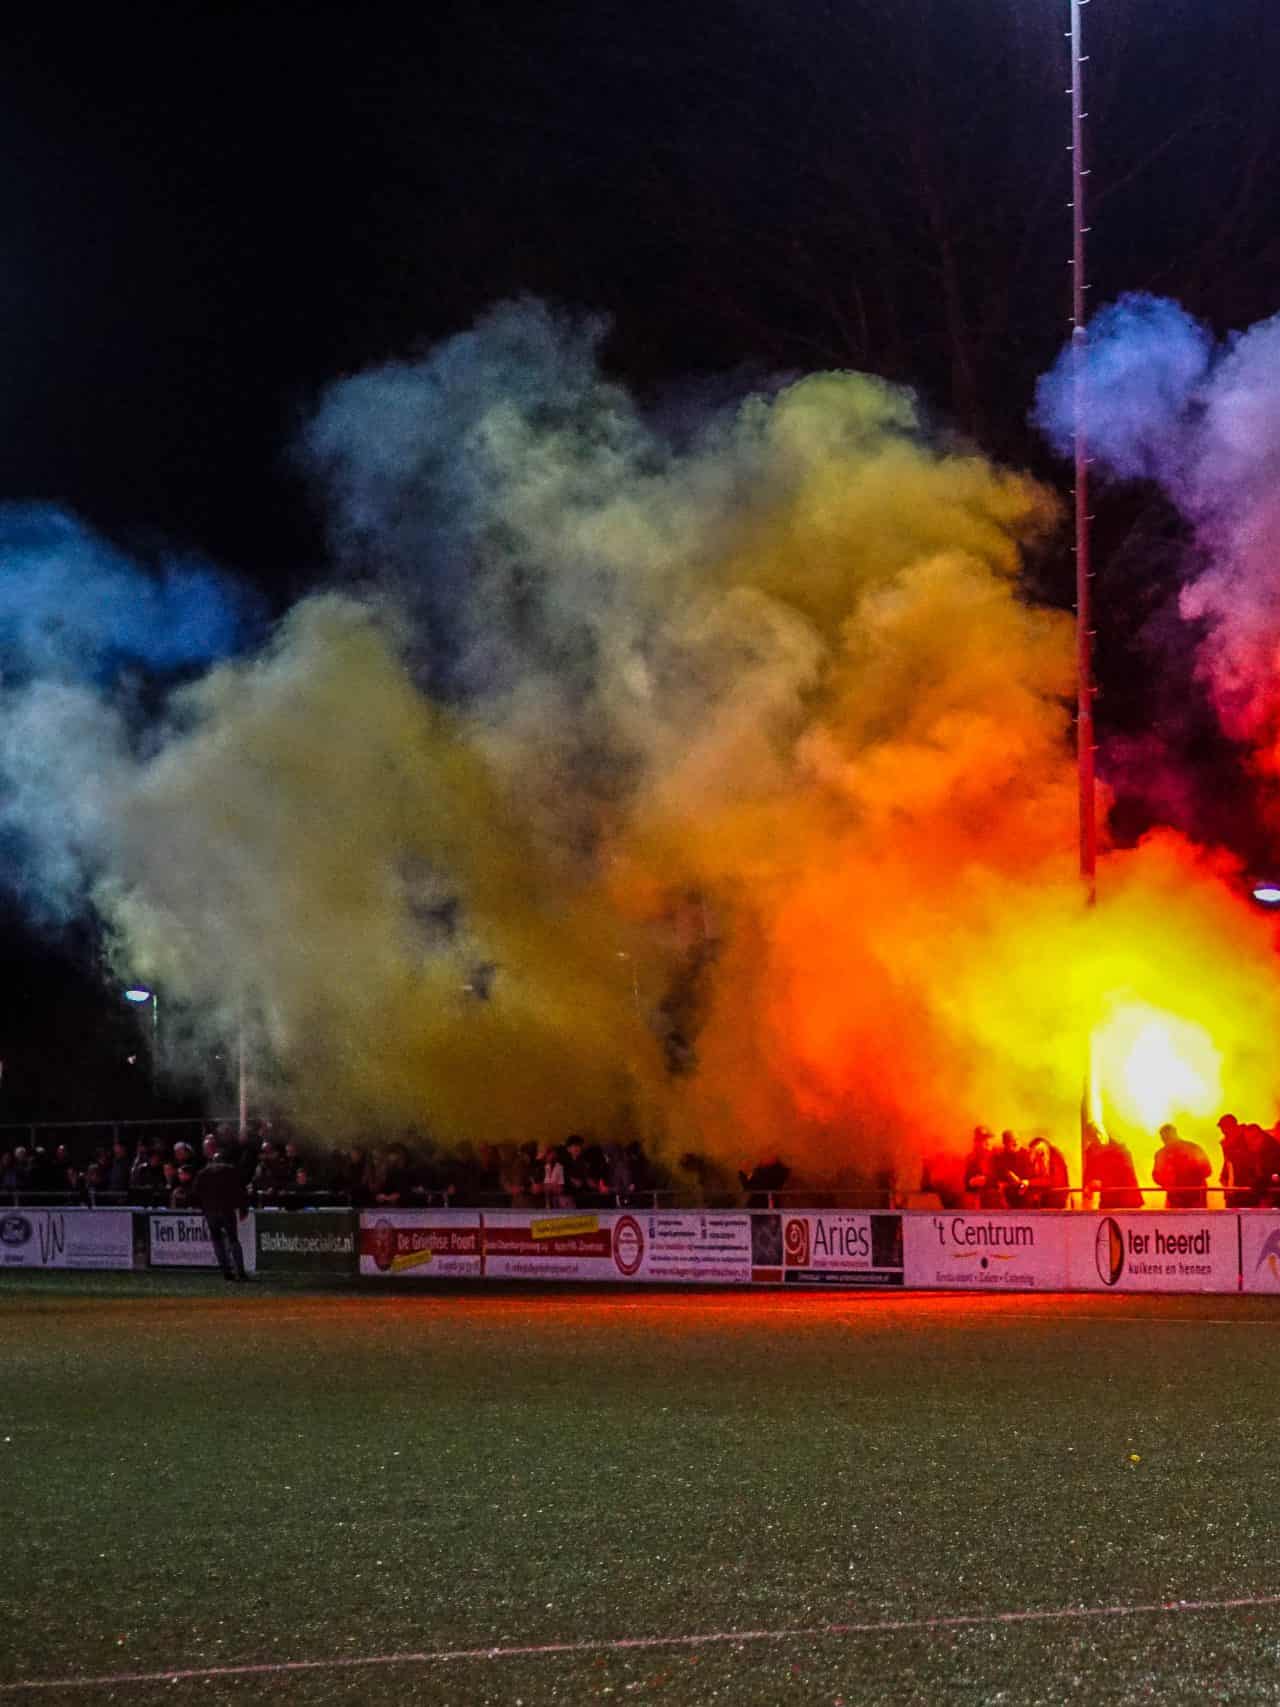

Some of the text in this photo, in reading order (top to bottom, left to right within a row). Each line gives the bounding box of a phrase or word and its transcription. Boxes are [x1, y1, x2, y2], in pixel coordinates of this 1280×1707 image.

[152, 1220, 174, 1242] Ten
[814, 1218, 870, 1257] Ariës
[932, 1217, 1034, 1246] 't Centrum
[1127, 1229, 1211, 1254] ter heerdt
